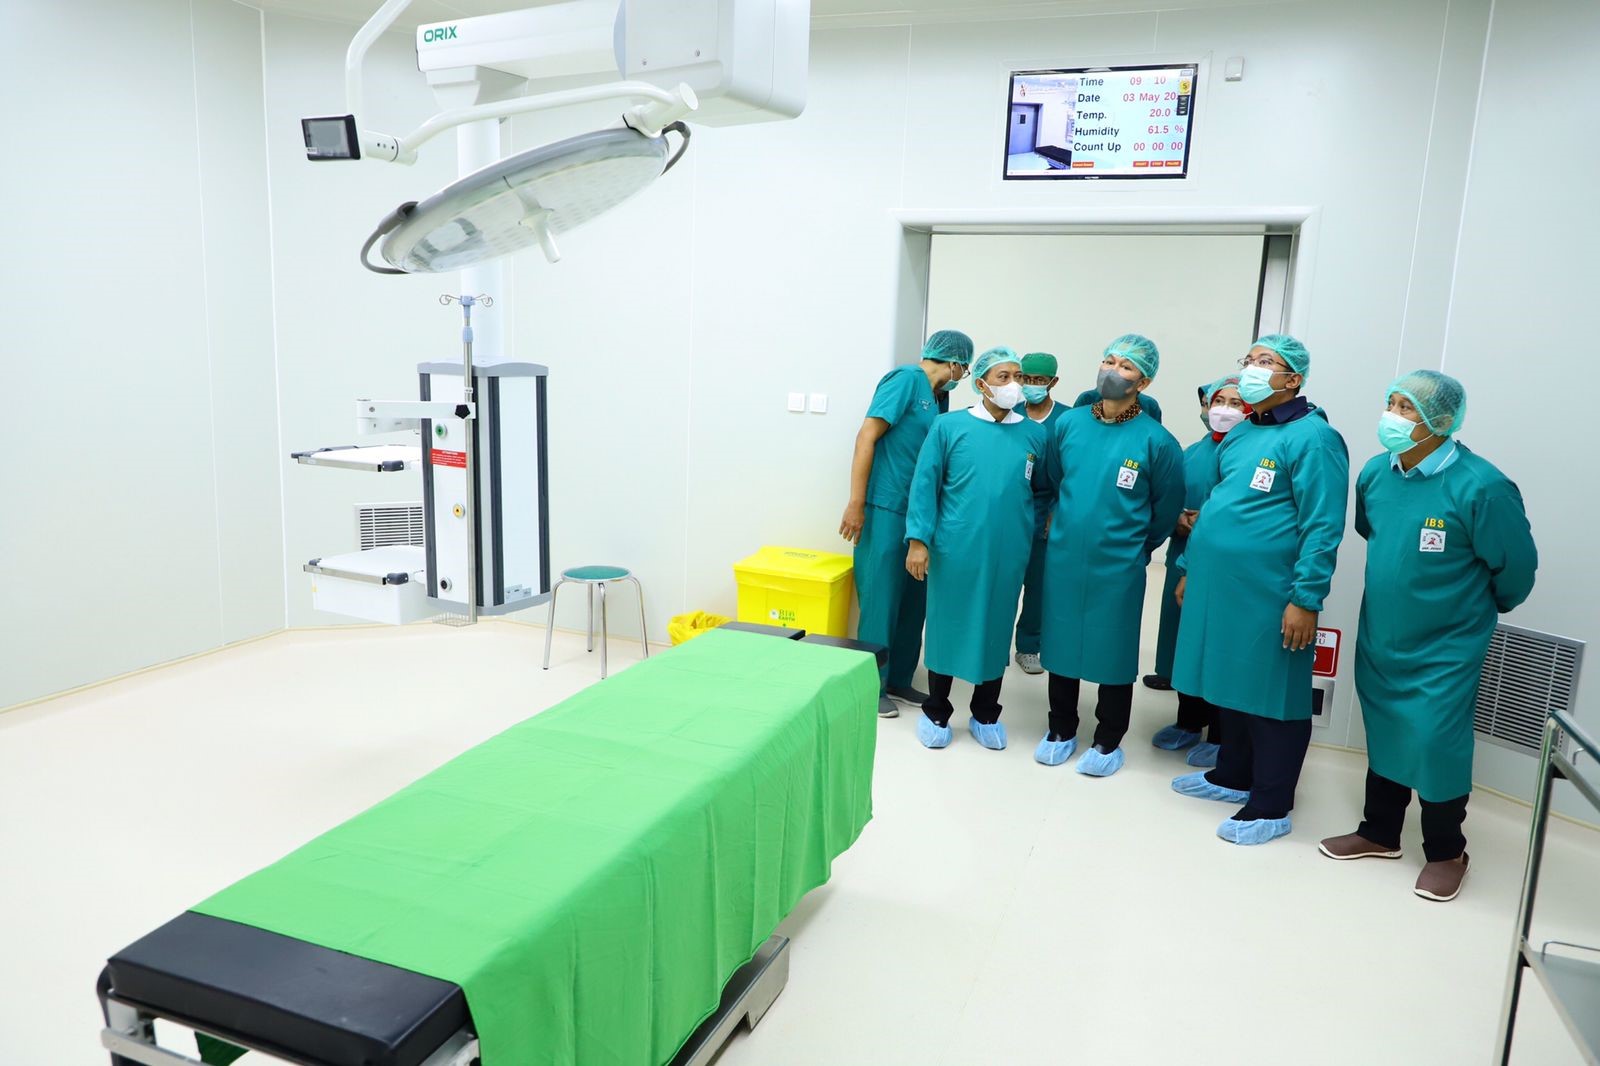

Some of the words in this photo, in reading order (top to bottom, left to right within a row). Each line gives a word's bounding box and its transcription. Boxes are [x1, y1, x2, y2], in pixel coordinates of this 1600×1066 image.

[424, 25, 457, 42] ORIX
[1079, 77, 1104, 87] Time
[1129, 76, 1142, 86] 09
[1153, 76, 1166, 85] 10
[1077, 93, 1101, 103] Date
[1122, 93, 1135, 102] 03
[1139, 92, 1160, 104] May
[1076, 110, 1107, 121] Temp.
[1149, 108, 1171, 118] 20.0
[1074, 126, 1120, 137] Humidity
[1147, 125, 1169, 135] 61.5
[1073, 142, 1104, 152] Count
[1107, 142, 1121, 153] Up
[1133, 142, 1146, 151] 00
[1151, 142, 1164, 151] 00
[1170, 141, 1183, 150] 00
[1123, 458, 1139, 470] IBS
[1260, 457, 1276, 469] IBS
[1425, 517, 1445, 528] IBS
